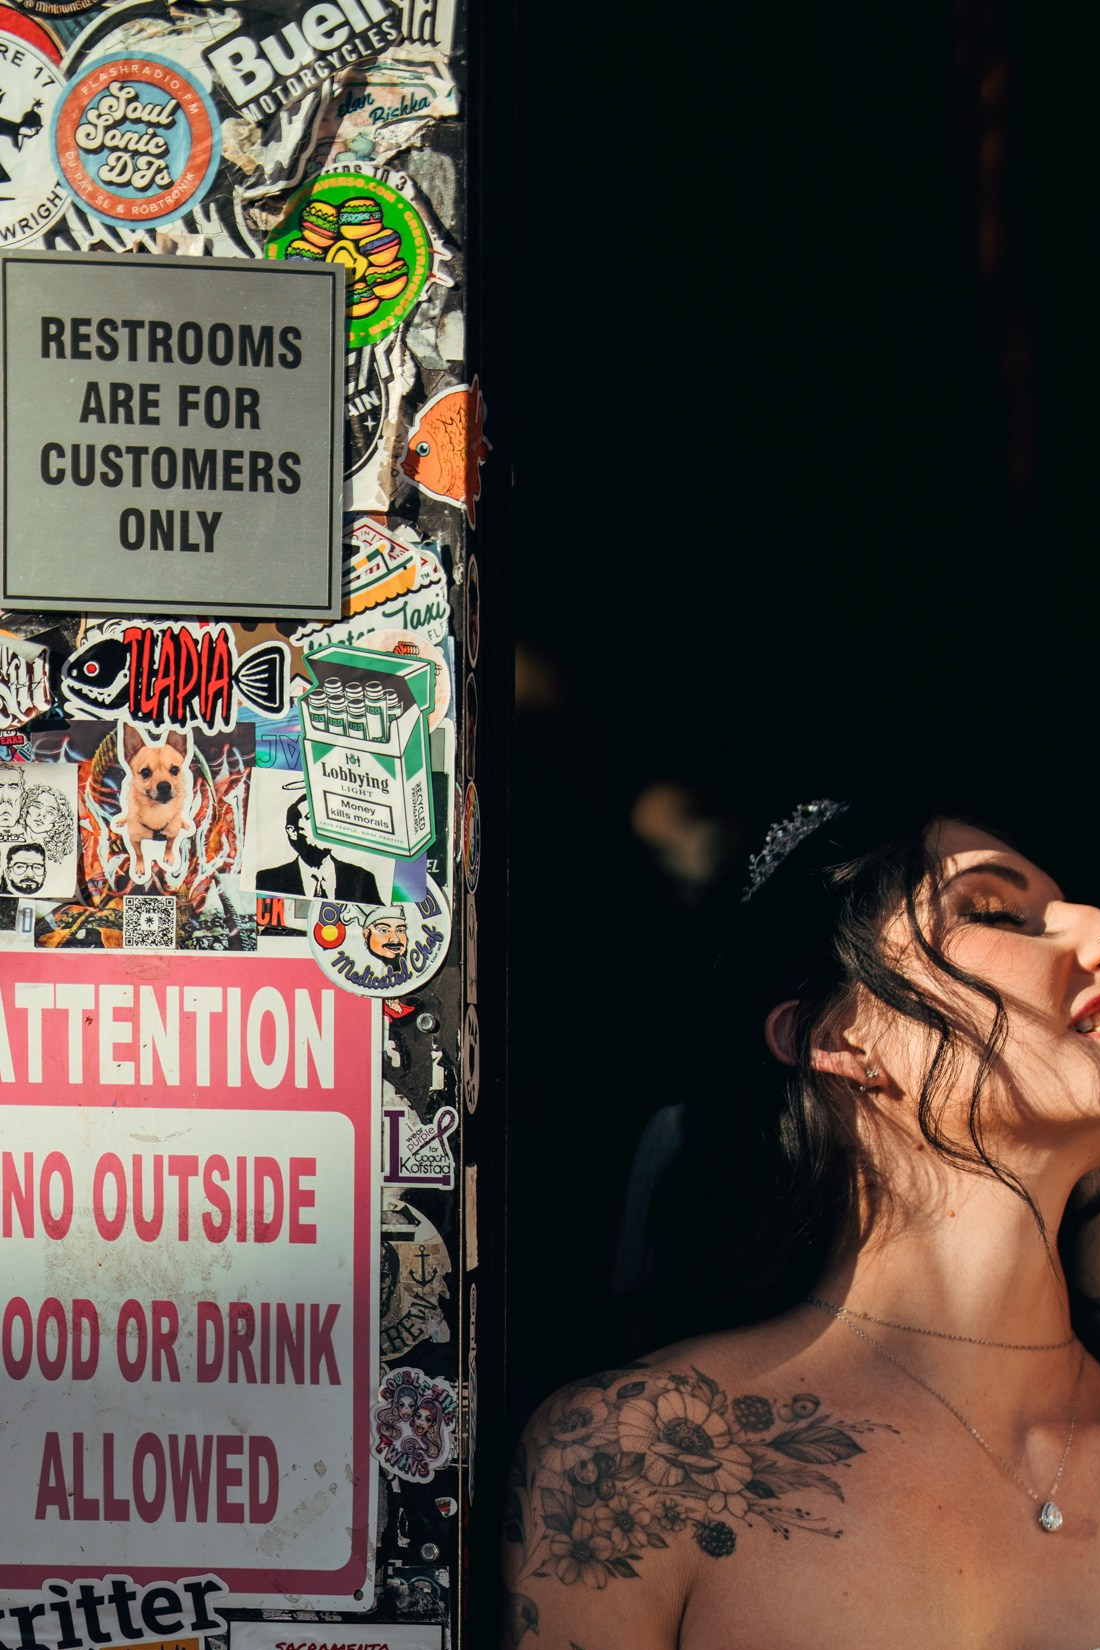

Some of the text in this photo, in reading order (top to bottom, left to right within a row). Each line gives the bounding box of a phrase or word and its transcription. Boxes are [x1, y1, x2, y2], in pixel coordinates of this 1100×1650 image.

[33, 66, 56, 88] 17
[82, 64, 200, 115] FLASHRADIO.FM
[241, 20, 397, 122] MOTORCYCLES
[98, 81, 179, 127] Soul
[75, 107, 168, 151] Sonic
[98, 151, 173, 190] DJs
[131, 171, 196, 216] ROBTRONIK
[40, 316, 302, 369] RESTROOMS
[79, 381, 261, 430] ARE FOR
[40, 442, 302, 495] CUSTOMERS
[118, 507, 223, 553] ONLY
[381, 592, 446, 630] Taxi
[320, 761, 390, 794] Lobbying
[341, 784, 374, 798] LIGHT
[330, 807, 390, 829] kills morals
[341, 799, 376, 815] Money
[331, 950, 413, 990] Medicated
[409, 923, 445, 973] Chef
[405, 1127, 424, 1143] wear
[406, 1126, 436, 1153] purple
[429, 1145, 439, 1153] for
[400, 1156, 451, 1175] Kofstad
[2, 1150, 318, 1245] NO OUTSIDE
[2, 1297, 342, 1386] OOD OR DRINK
[380, 1292, 439, 1357] REW
[380, 1369, 431, 1401] DOUBLE
[34, 1430, 280, 1525] ALLOWED
[375, 1435, 430, 1478] TWINS
